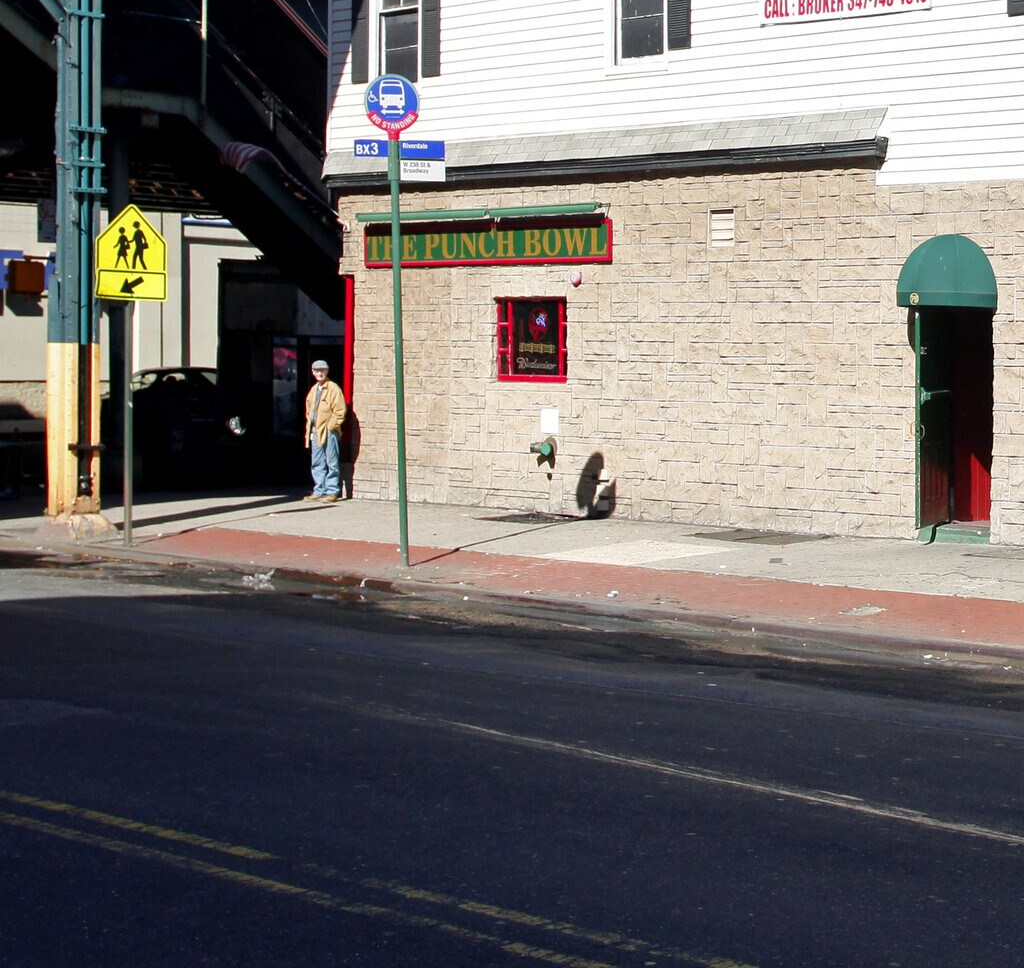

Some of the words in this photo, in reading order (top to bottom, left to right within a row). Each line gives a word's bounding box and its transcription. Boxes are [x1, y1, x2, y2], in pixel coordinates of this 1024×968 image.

[371, 113, 381, 124] NO
[381, 113, 415, 130] STANDING
[356, 142, 379, 155] BX3
[402, 142, 428, 150] Riverdale
[423, 230, 516, 260] PUNCH
[523, 226, 608, 257] BOWL
